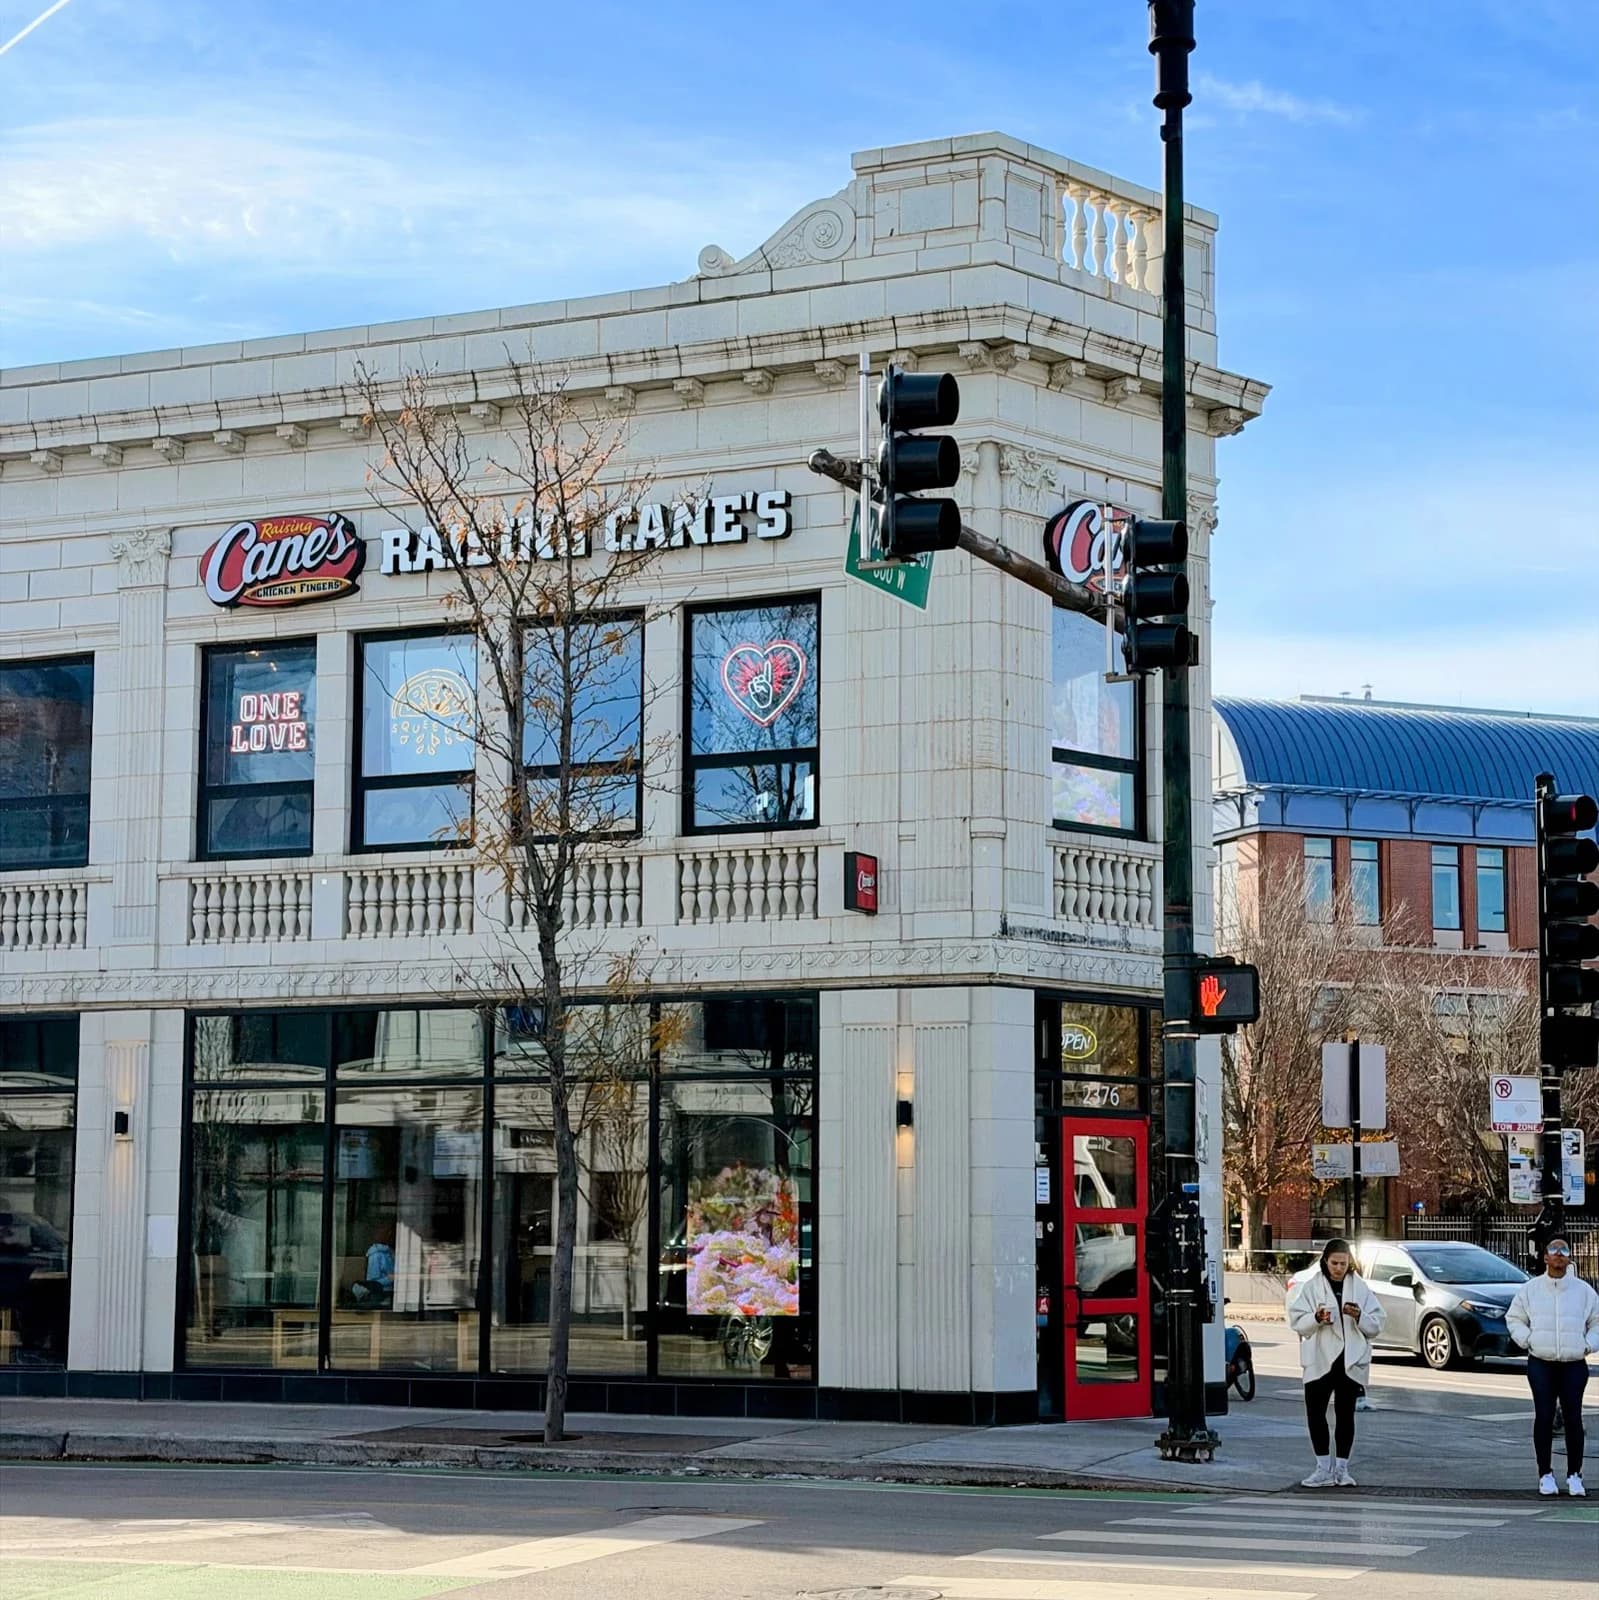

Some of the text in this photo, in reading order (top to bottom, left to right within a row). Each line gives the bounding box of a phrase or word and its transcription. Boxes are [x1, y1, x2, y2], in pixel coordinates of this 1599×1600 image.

[260, 519, 313, 539] Raising
[605, 489, 787, 552] CANE'S
[205, 511, 355, 603] Cane's
[256, 580, 341, 598] CHICKEN FINGERS
[239, 692, 300, 723] ONE
[230, 720, 307, 753] LOVE
[1083, 1086, 1119, 1107] 2376
[1496, 1123, 1538, 1132] TOW ZONE
